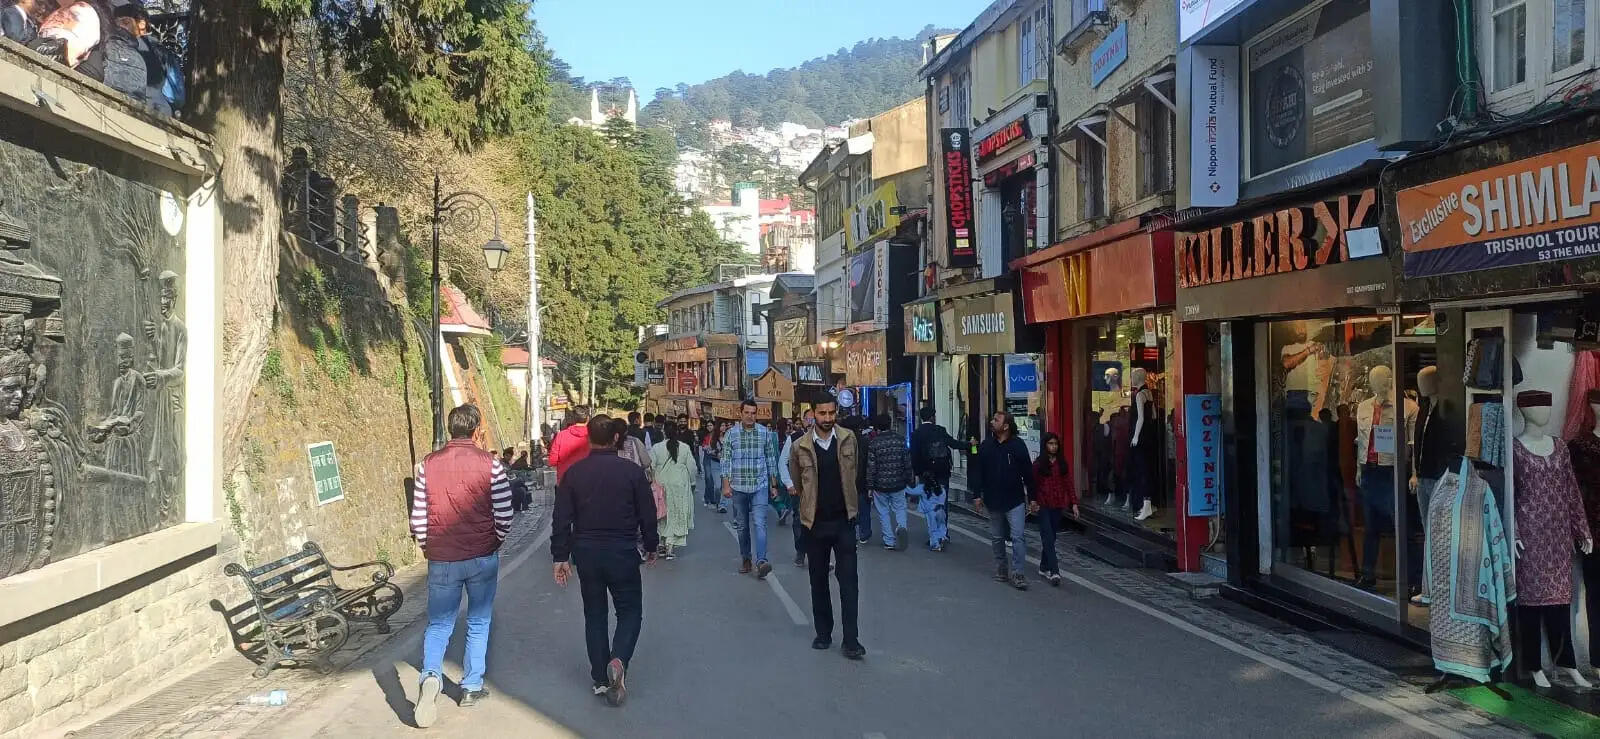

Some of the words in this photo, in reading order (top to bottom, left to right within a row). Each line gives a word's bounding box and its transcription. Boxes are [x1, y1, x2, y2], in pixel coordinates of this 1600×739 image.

[1208, 57, 1217, 80] Fund
[1208, 82, 1217, 114] Mutual
[1208, 143, 1218, 177] Nippon
[946, 151, 966, 228] CHOPSTICKS
[1409, 192, 1459, 243] Exclusive
[1179, 207, 1308, 289] KILLER
[1485, 234, 1553, 255] TRISHOOL
[1556, 225, 1600, 246] TOUR
[1538, 251, 1551, 261] 53
[1552, 247, 1573, 259] THE
[961, 312, 1005, 336] SAMSUNG
[1201, 399, 1216, 505] COZYNET
